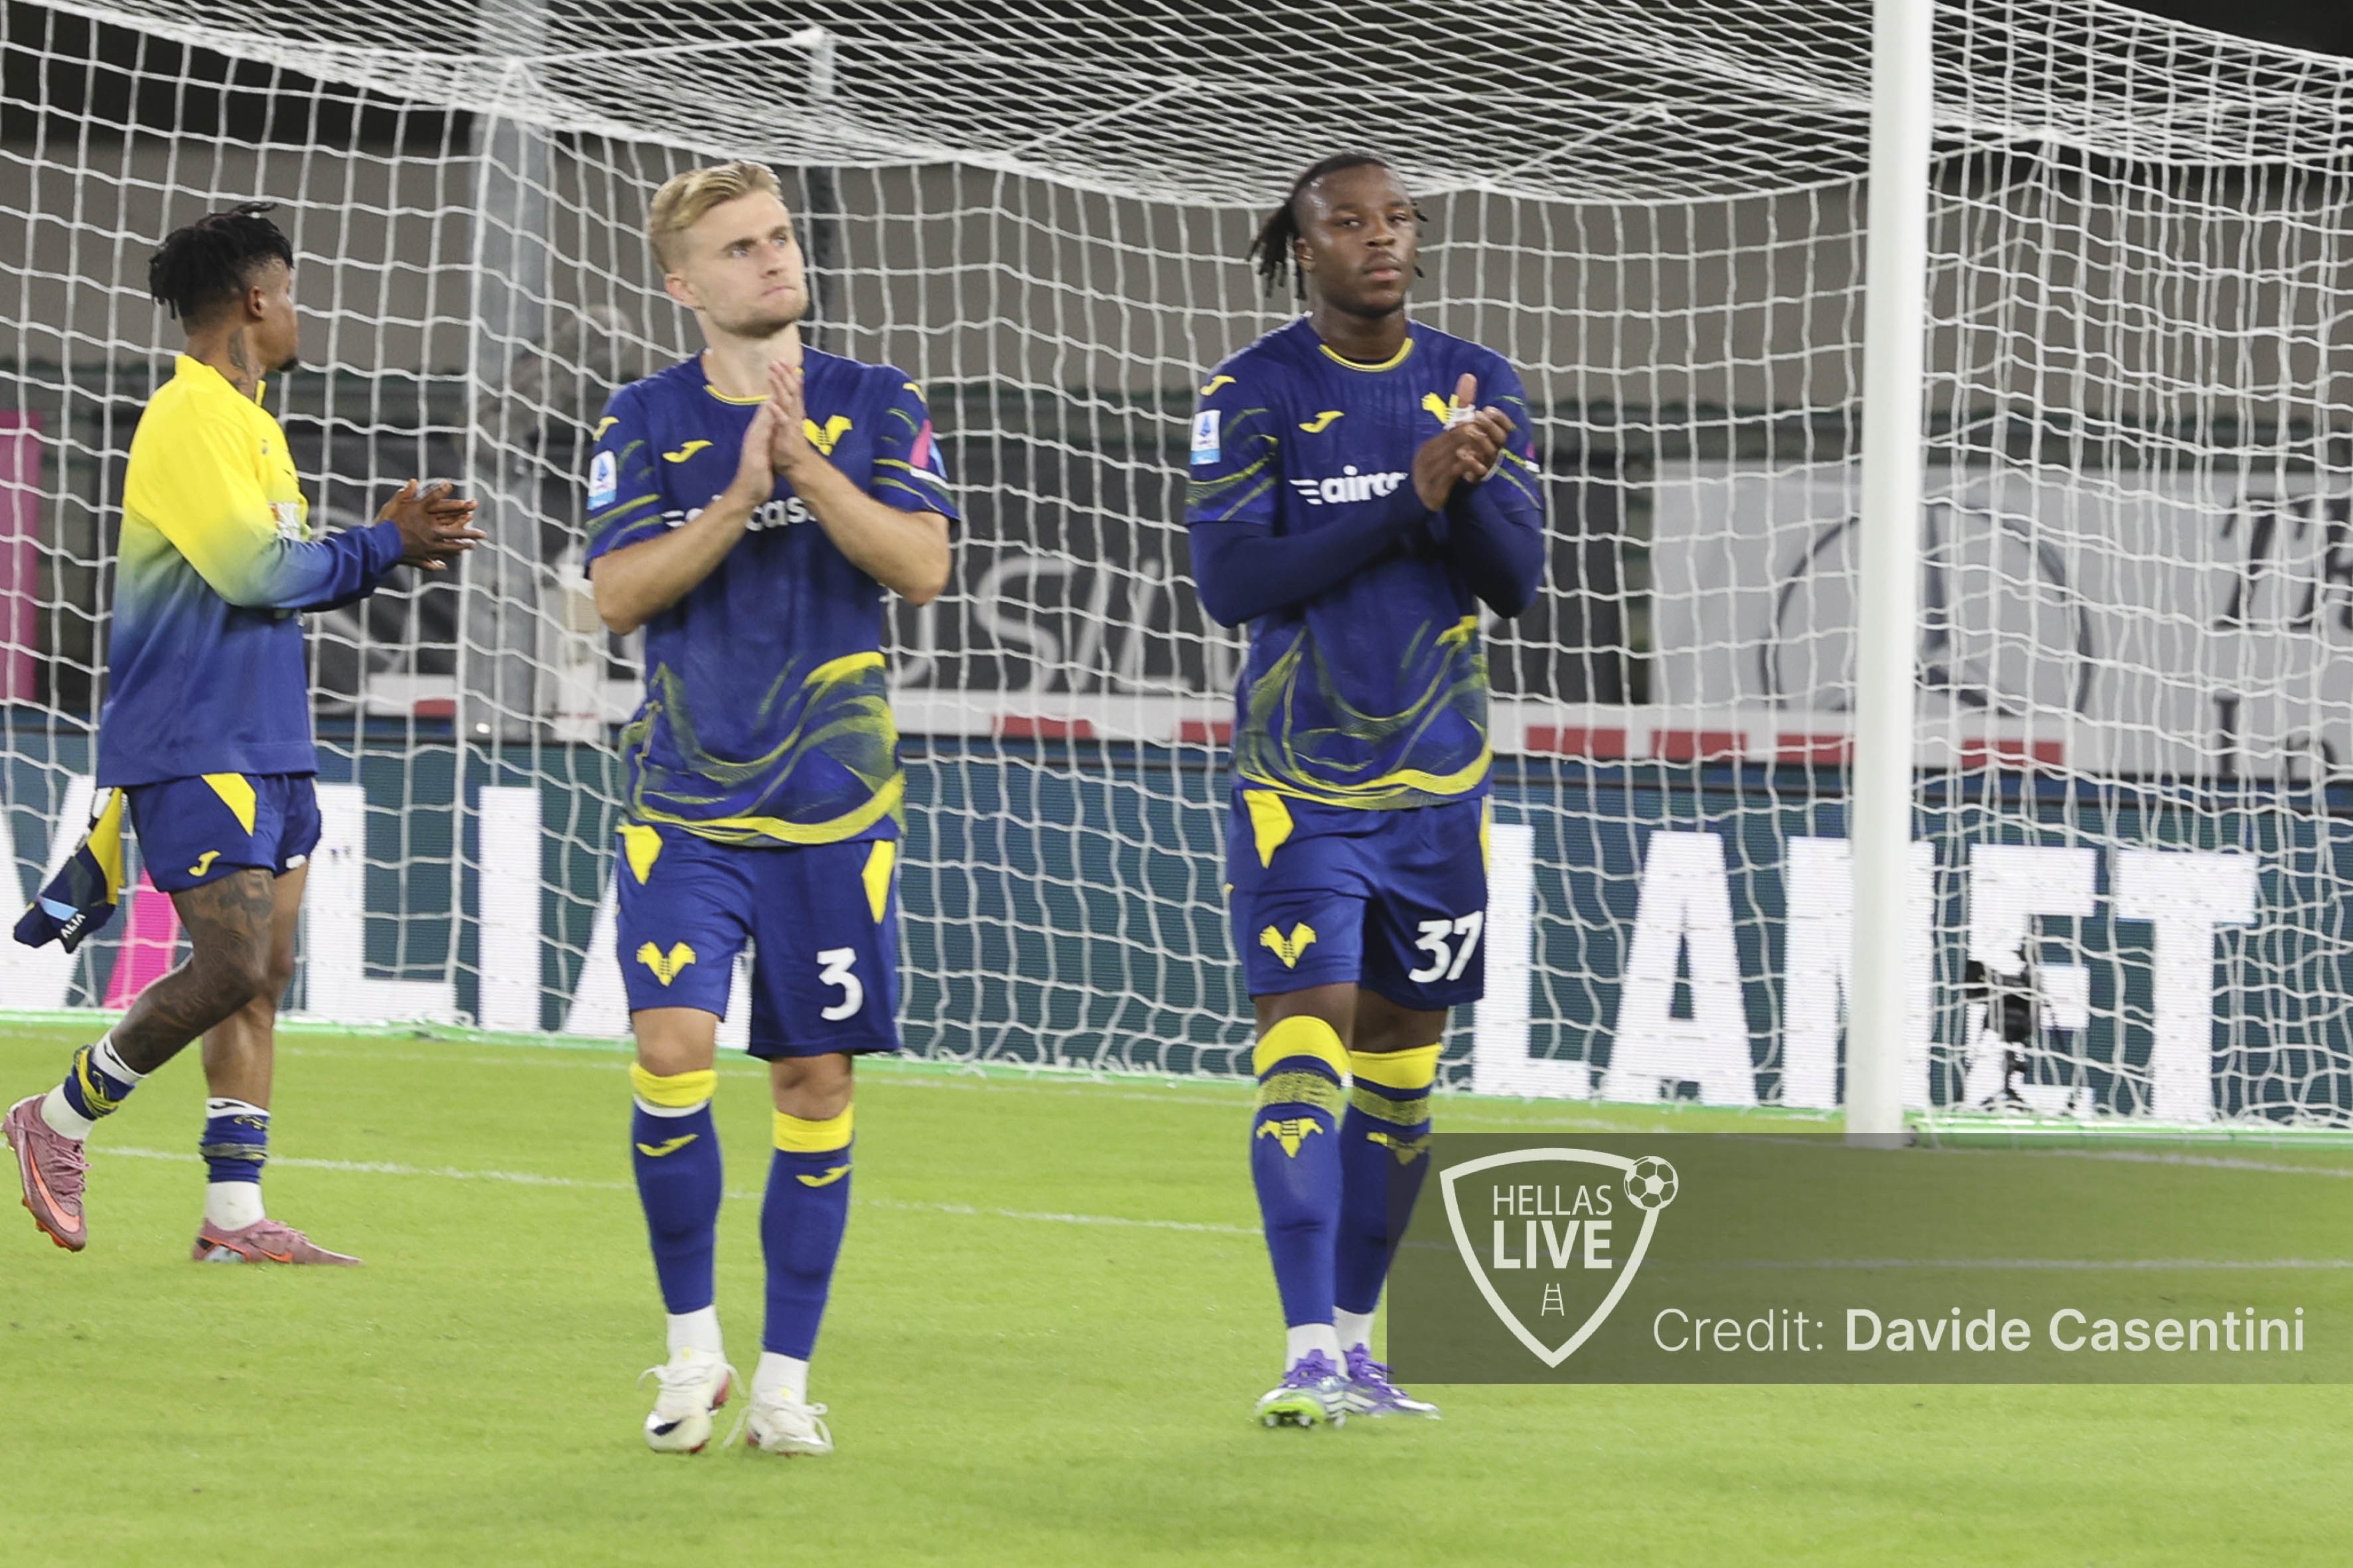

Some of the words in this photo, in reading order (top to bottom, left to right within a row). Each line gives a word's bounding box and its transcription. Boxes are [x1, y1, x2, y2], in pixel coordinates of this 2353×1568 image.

[817, 947, 862, 1021] 3
[1409, 911, 1483, 983] 37
[1472, 824, 2256, 1121] LANET
